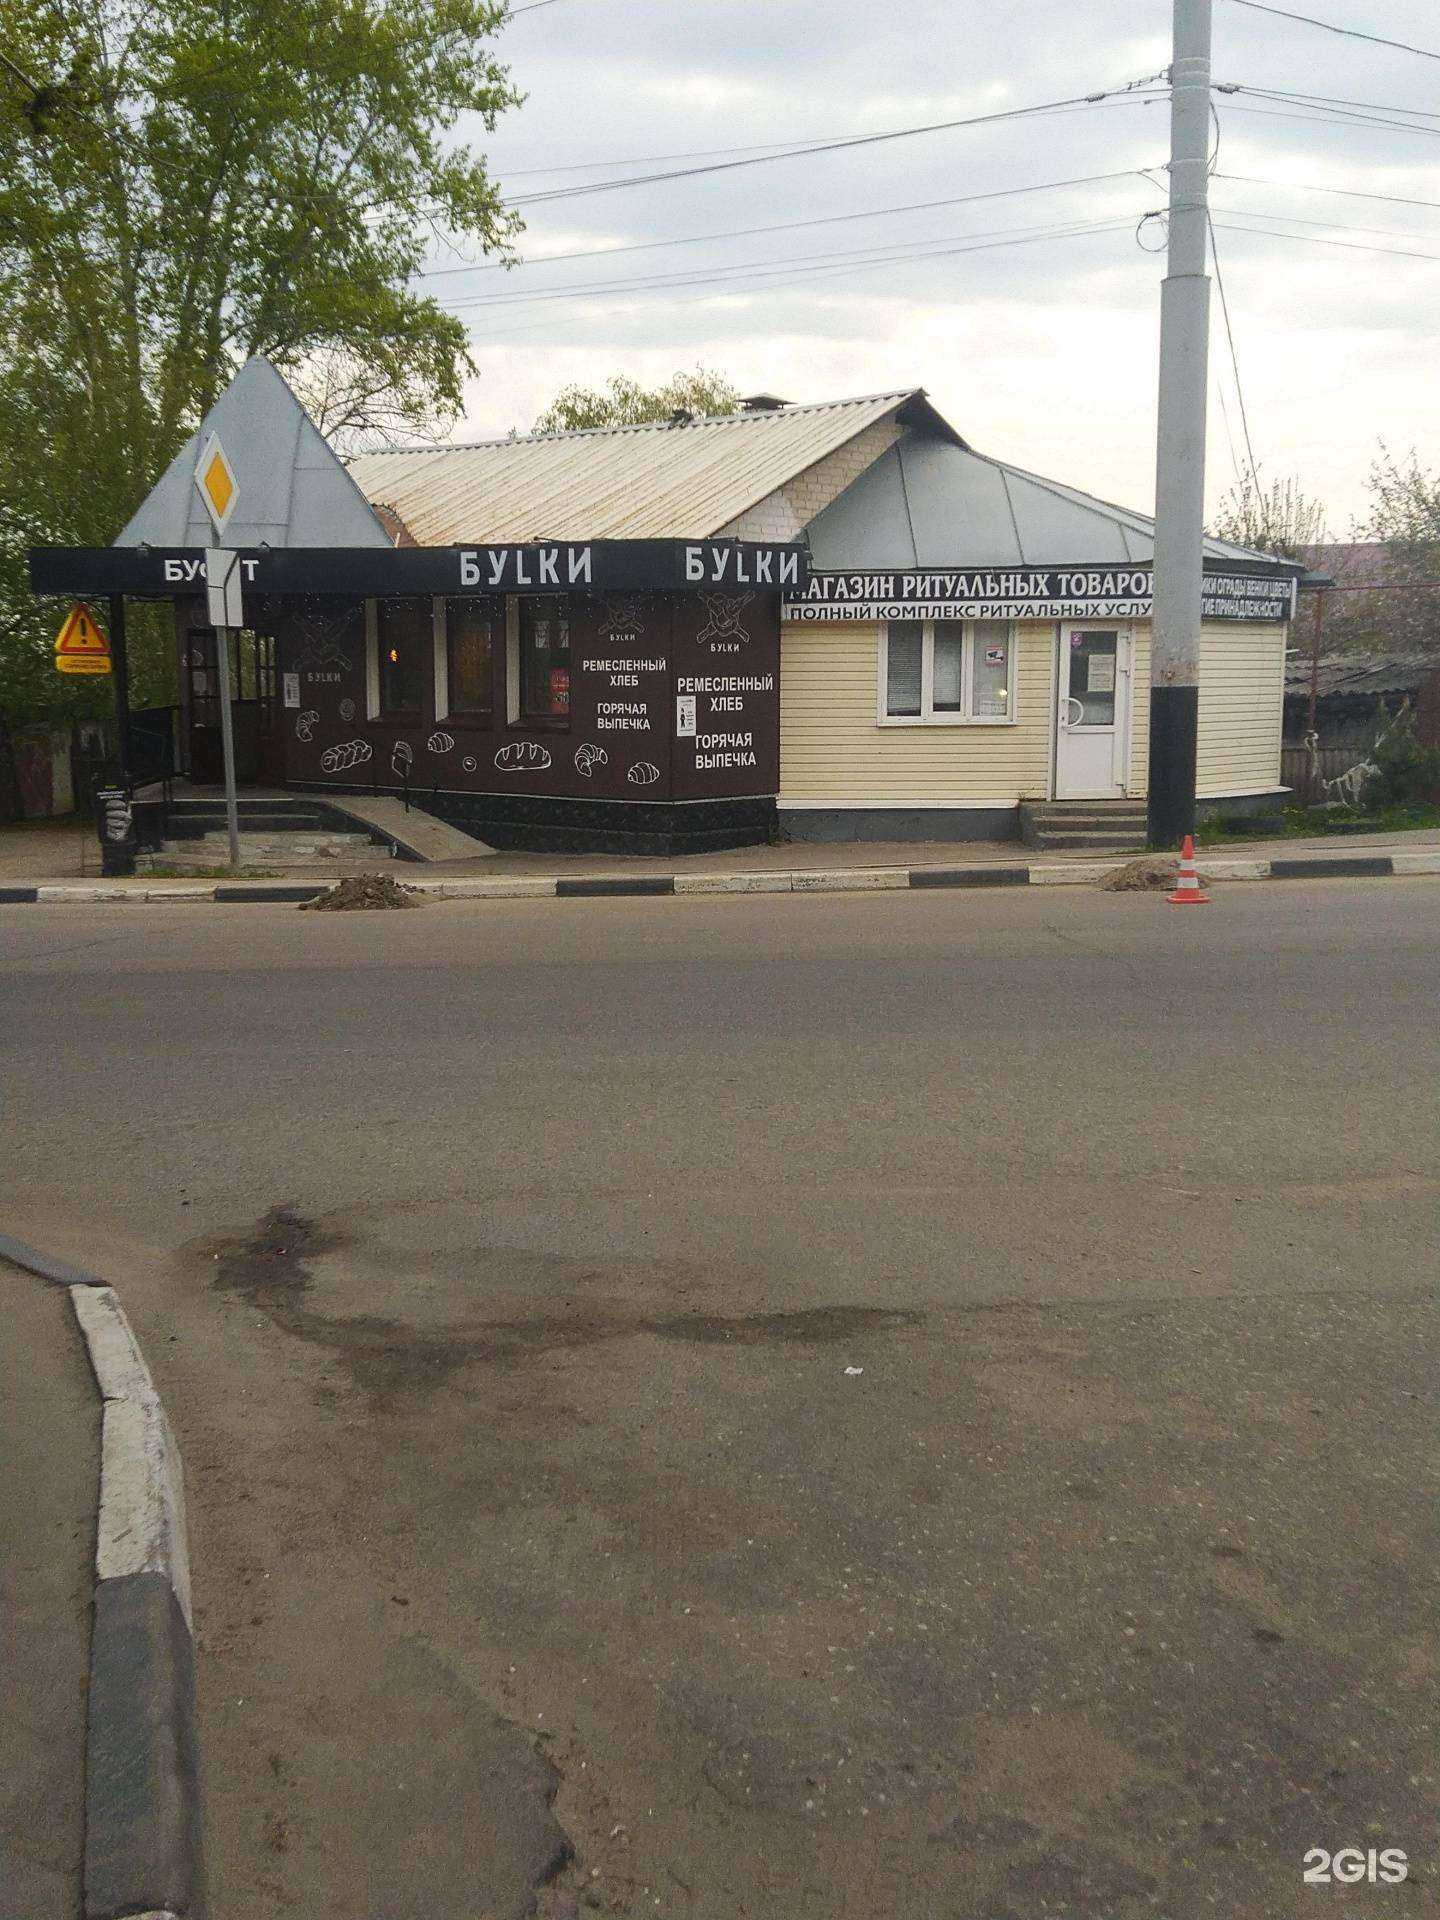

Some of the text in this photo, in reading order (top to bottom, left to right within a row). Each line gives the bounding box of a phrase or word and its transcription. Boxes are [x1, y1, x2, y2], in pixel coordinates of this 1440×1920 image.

[164, 560, 259, 581] БУТ
[790, 575, 894, 599] АГАЗИН
[902, 574, 1050, 598] РИТУАЛЬНЫХ
[1217, 578, 1246, 599] ОГРАДЫ
[790, 602, 1153, 620] ПОЛНЫЙ КОМПЛЕКС РИТУАЛЬНЫХ УСЛУ
[1215, 599, 1282, 618] ПРИНАДЛЕЖНОСТИ
[582, 657, 666, 671] РЕМЕСЛЕННЫЙ
[609, 675, 639, 686] ХЛЕБ
[677, 673, 773, 692] РЕМЕСЛЕННЫЙ
[597, 703, 647, 715] ГОРЯЧАЯ
[710, 697, 744, 711] ХЛЕБ
[597, 718, 651, 730] ВЫПЕЧКА
[695, 732, 752, 749] ГОРЯЧАЯ
[695, 752, 757, 769] ВЫПЕЧКА
